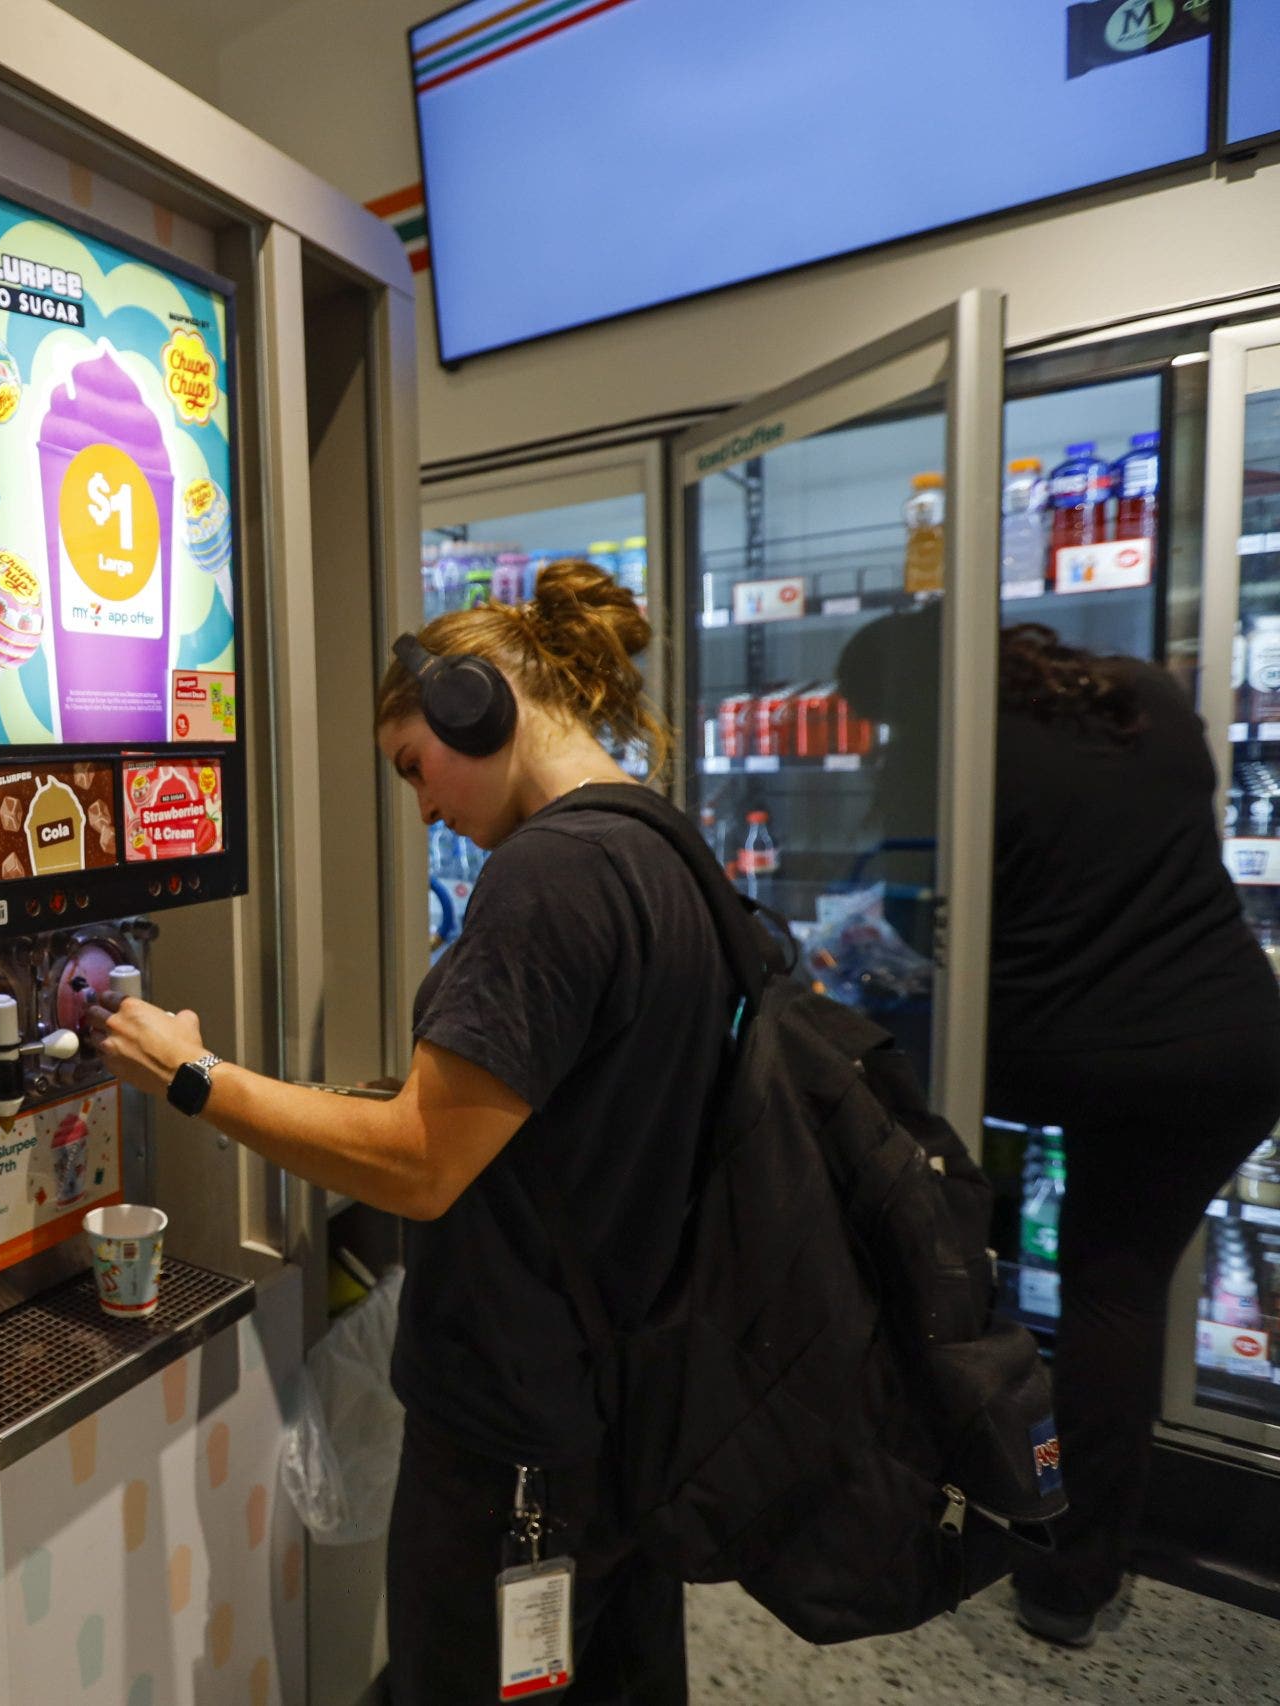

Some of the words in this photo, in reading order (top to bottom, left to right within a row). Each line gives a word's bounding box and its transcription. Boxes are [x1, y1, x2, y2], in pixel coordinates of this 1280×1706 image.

[19, 293, 80, 326] SUGAR
[170, 349, 210, 378] Chupa
[170, 373, 210, 410] Chups
[87, 472, 133, 550] $1
[109, 612, 128, 625] app
[130, 612, 154, 625] offer
[143, 803, 204, 824] Strawberries
[40, 823, 70, 842] Cola
[154, 827, 162, 840] &
[163, 826, 195, 840] Cream
